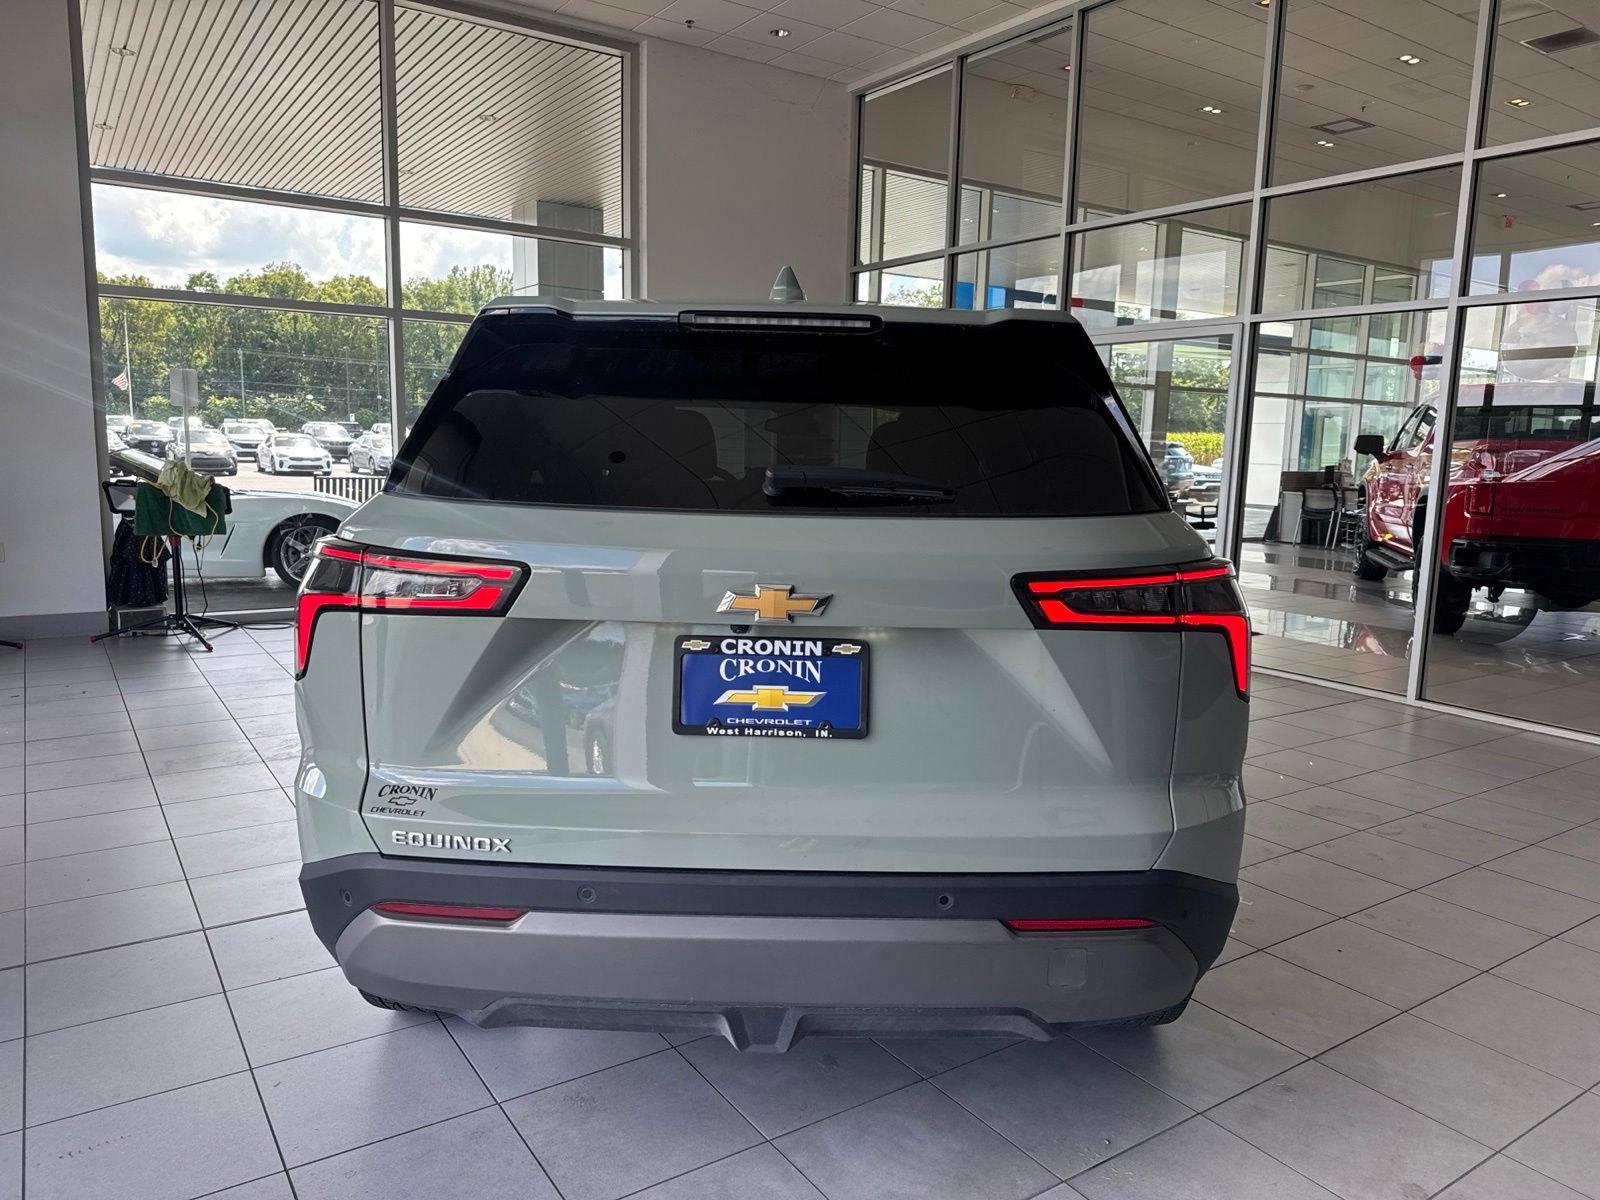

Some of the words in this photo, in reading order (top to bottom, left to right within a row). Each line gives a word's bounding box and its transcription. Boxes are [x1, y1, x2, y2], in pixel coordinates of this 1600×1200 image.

[720, 638, 822, 656] CRONIN
[719, 658, 823, 684] CRONIN
[726, 717, 813, 726] CHEVROLET
[706, 727, 740, 736] West
[744, 728, 807, 738] Harrison,
[815, 730, 833, 738] IN.
[378, 784, 439, 801] CRONIN
[370, 806, 427, 817] CHEVROLET
[391, 830, 512, 853] EQUINOX
